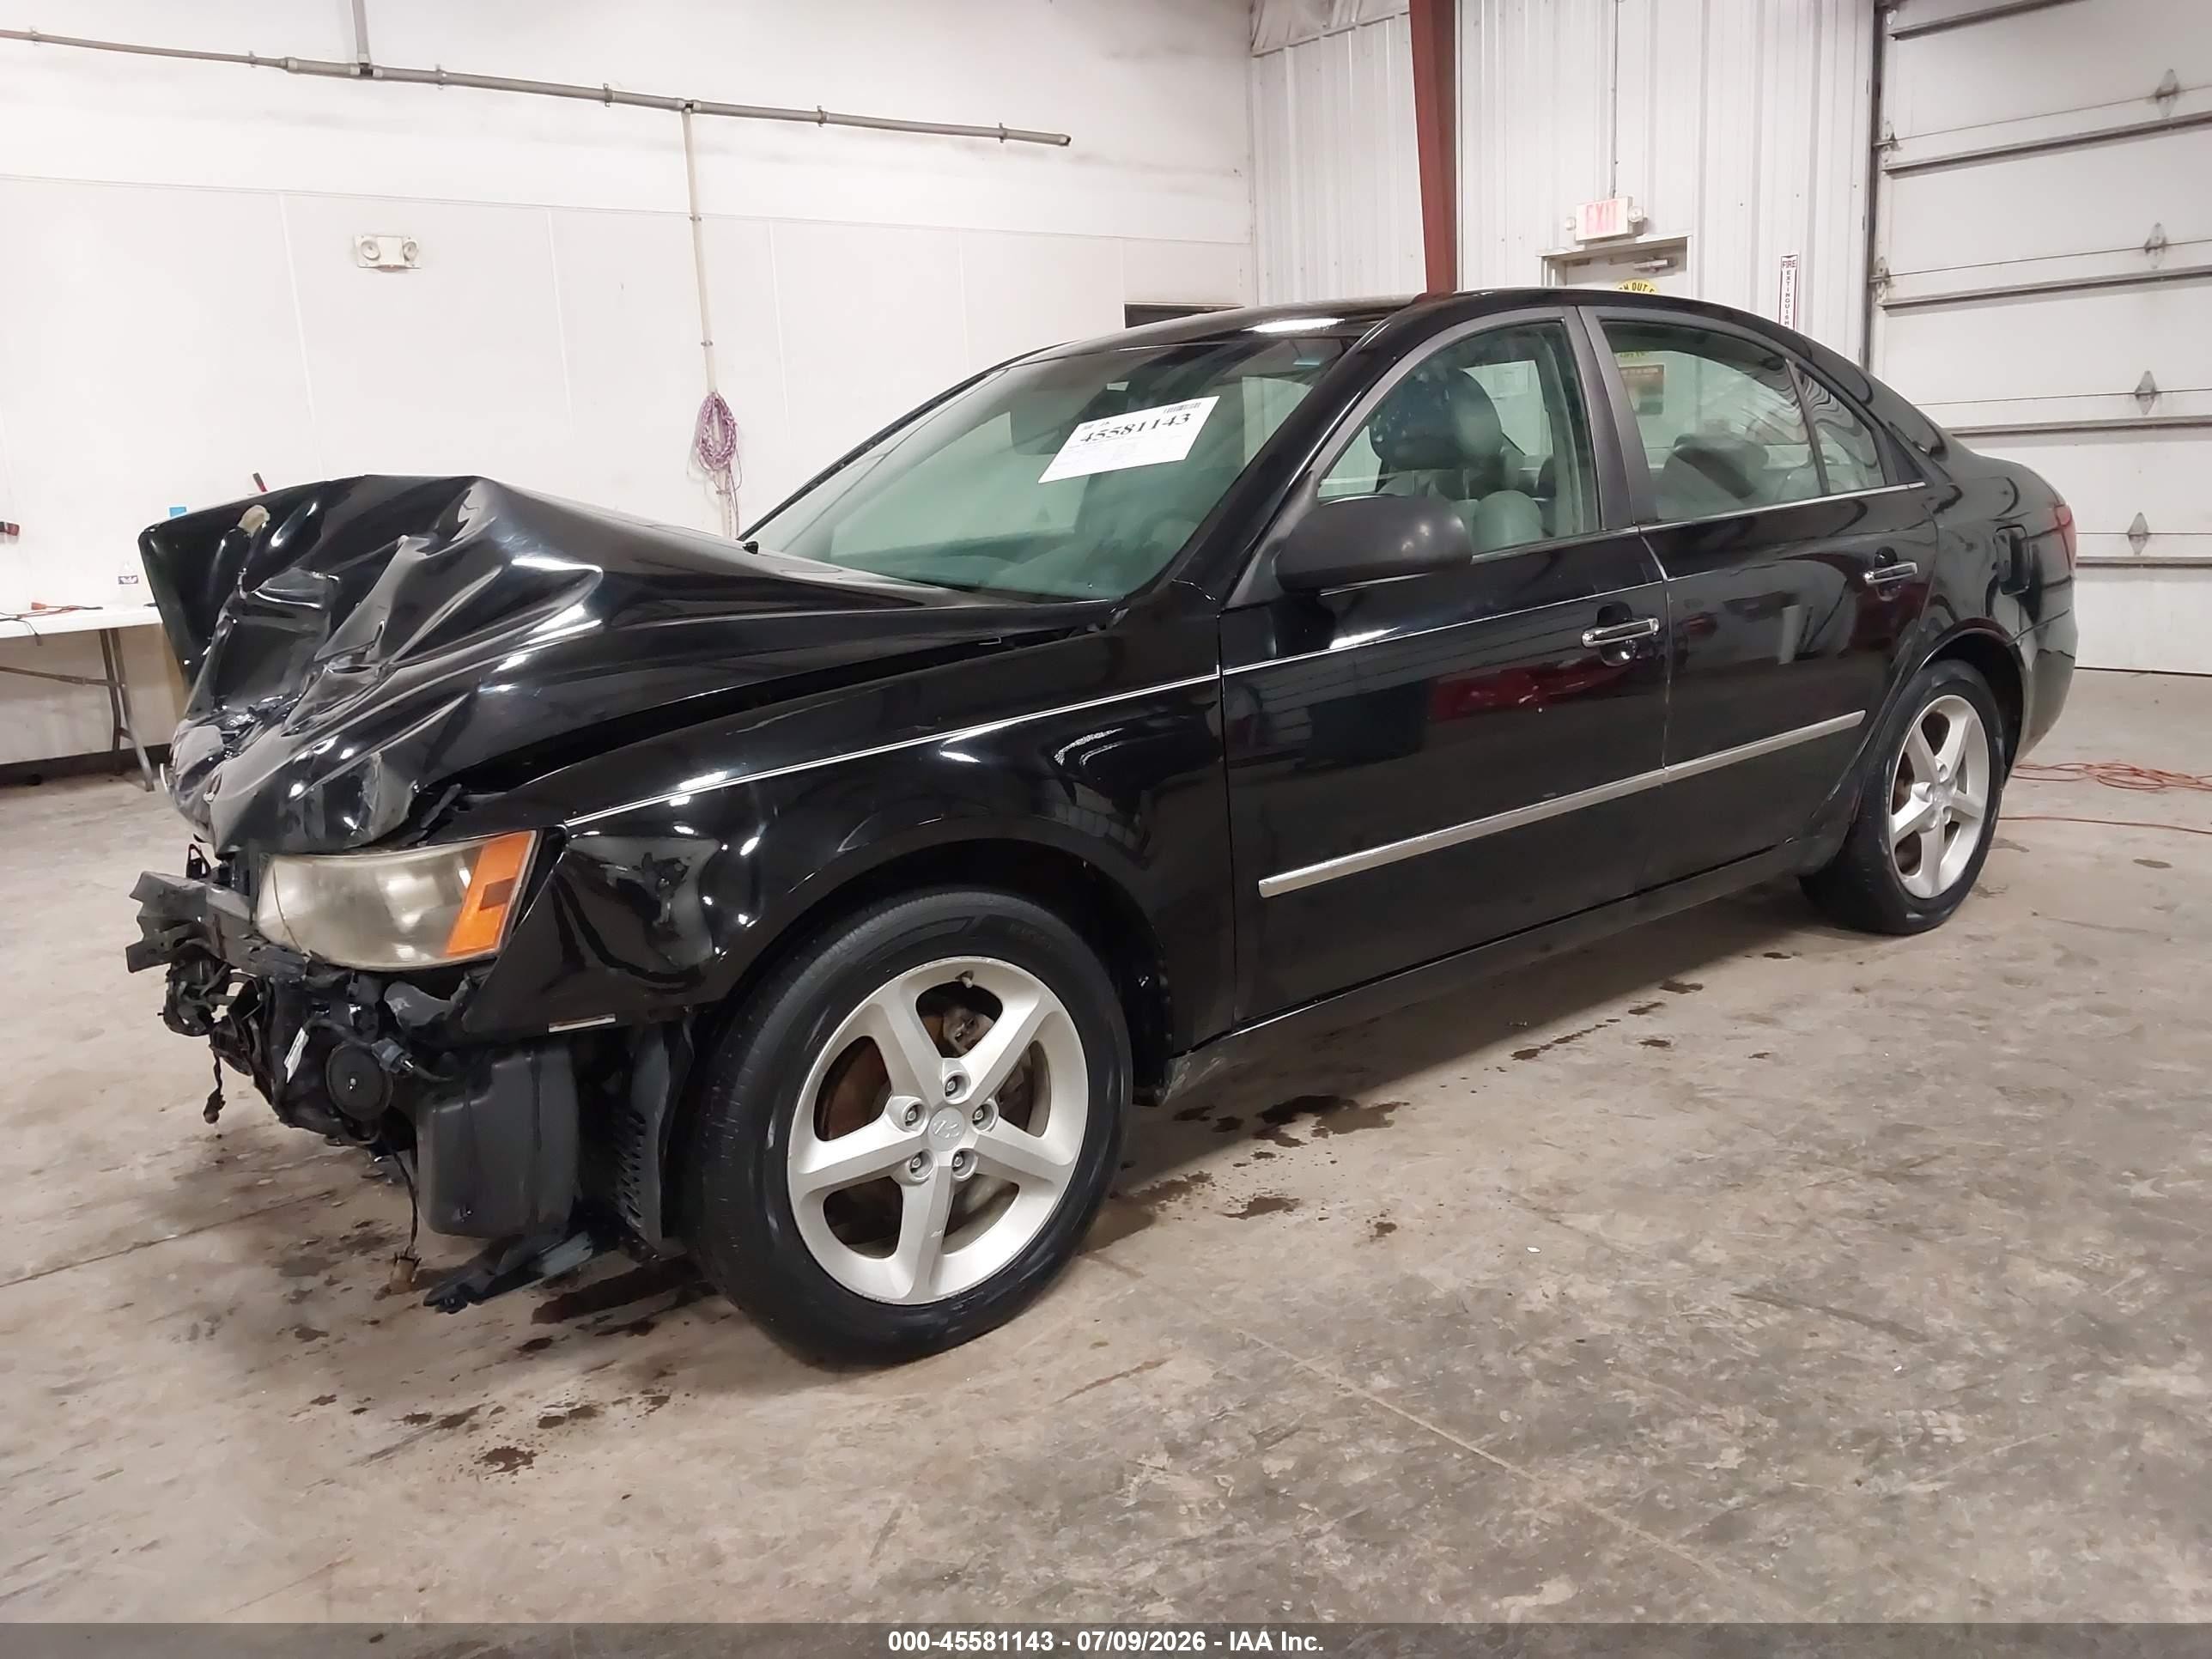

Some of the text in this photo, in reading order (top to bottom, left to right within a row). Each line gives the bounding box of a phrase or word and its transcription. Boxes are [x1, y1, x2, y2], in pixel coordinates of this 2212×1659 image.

[1585, 199, 1619, 235] EXIT
[1782, 259, 1796, 269] FIRE
[1632, 282, 1649, 292] OUT
[1079, 412, 1192, 443] 45581143
